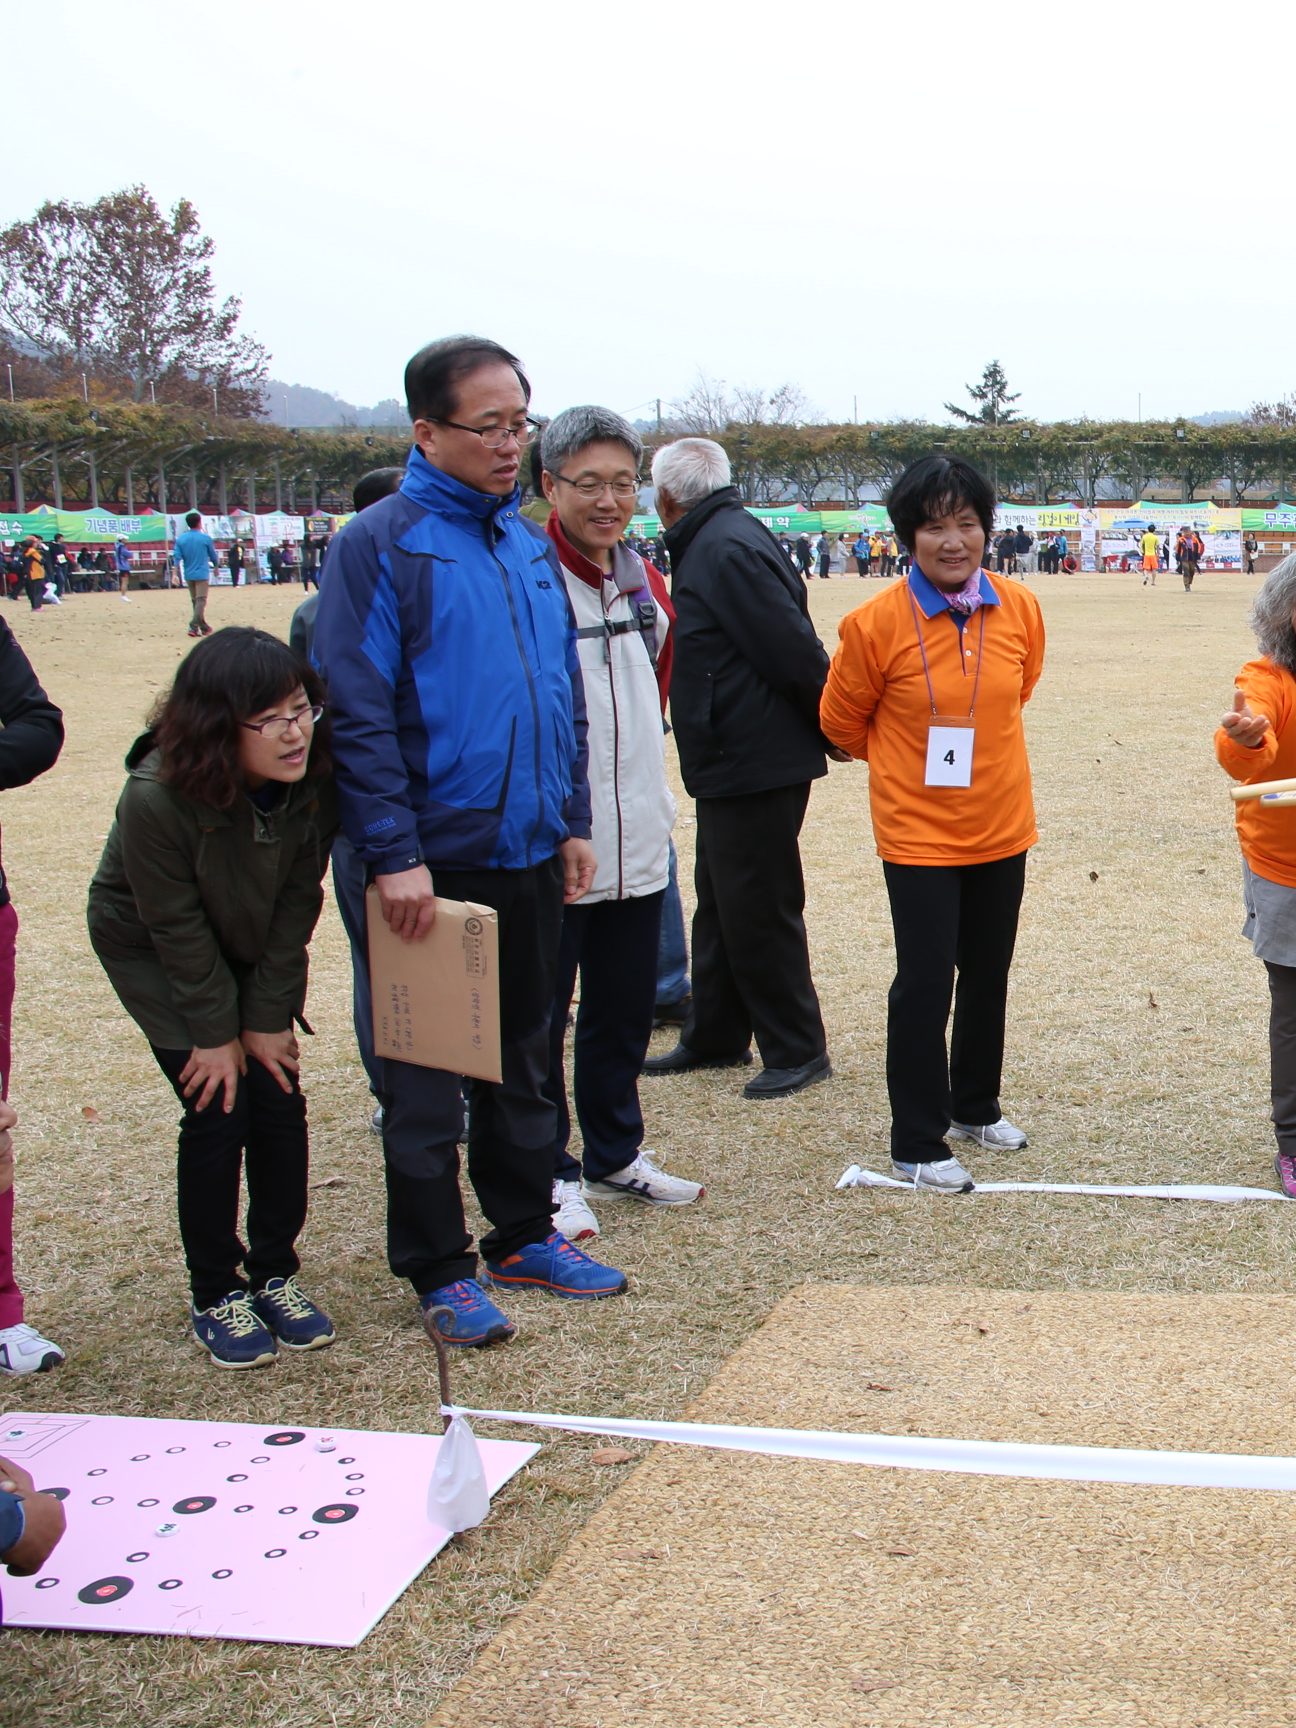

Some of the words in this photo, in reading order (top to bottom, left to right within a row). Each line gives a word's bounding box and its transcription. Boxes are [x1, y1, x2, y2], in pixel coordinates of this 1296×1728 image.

[85, 517, 118, 535] 기념품
[120, 517, 142, 535] 배부
[1004, 514, 1036, 526] 함께하는
[535, 580, 552, 590] K2
[943, 749, 955, 766] 4
